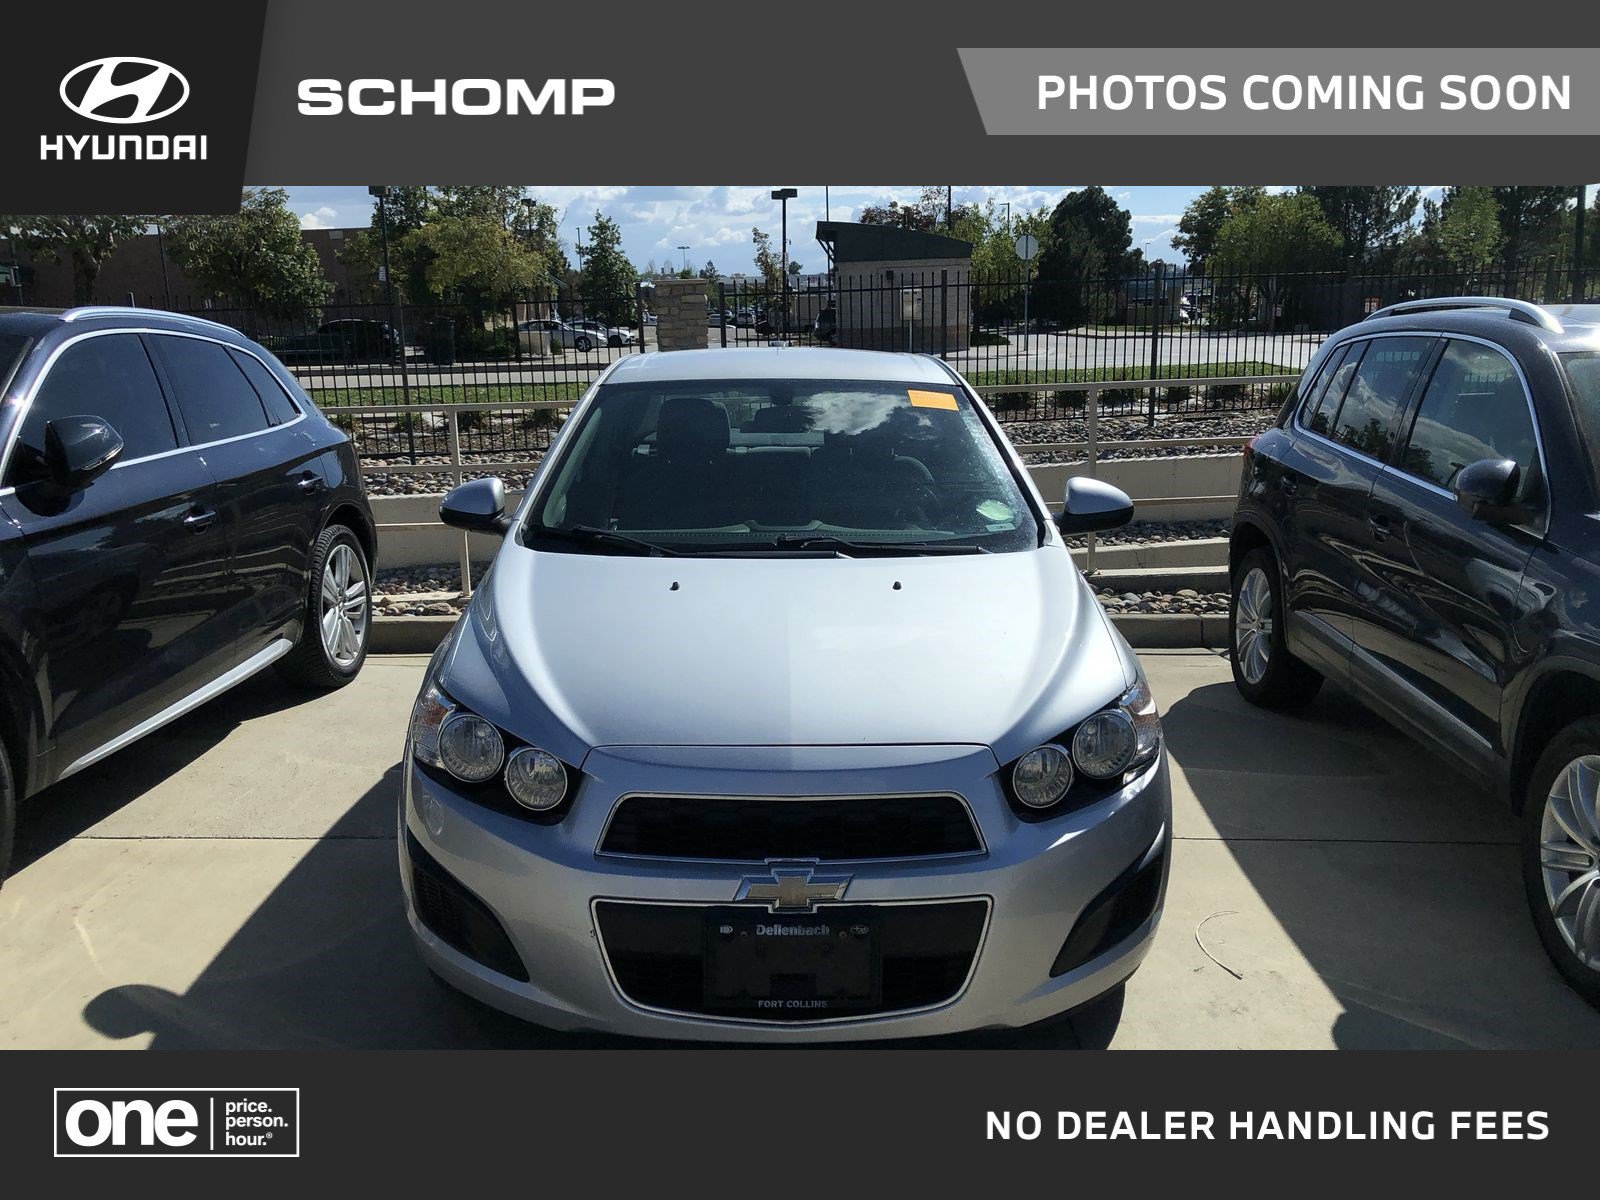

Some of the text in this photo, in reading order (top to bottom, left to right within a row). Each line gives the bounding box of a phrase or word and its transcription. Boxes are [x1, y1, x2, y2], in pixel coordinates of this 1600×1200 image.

[755, 924, 831, 936] Dellenbach
[757, 999, 828, 1009] FORT COLLINS
